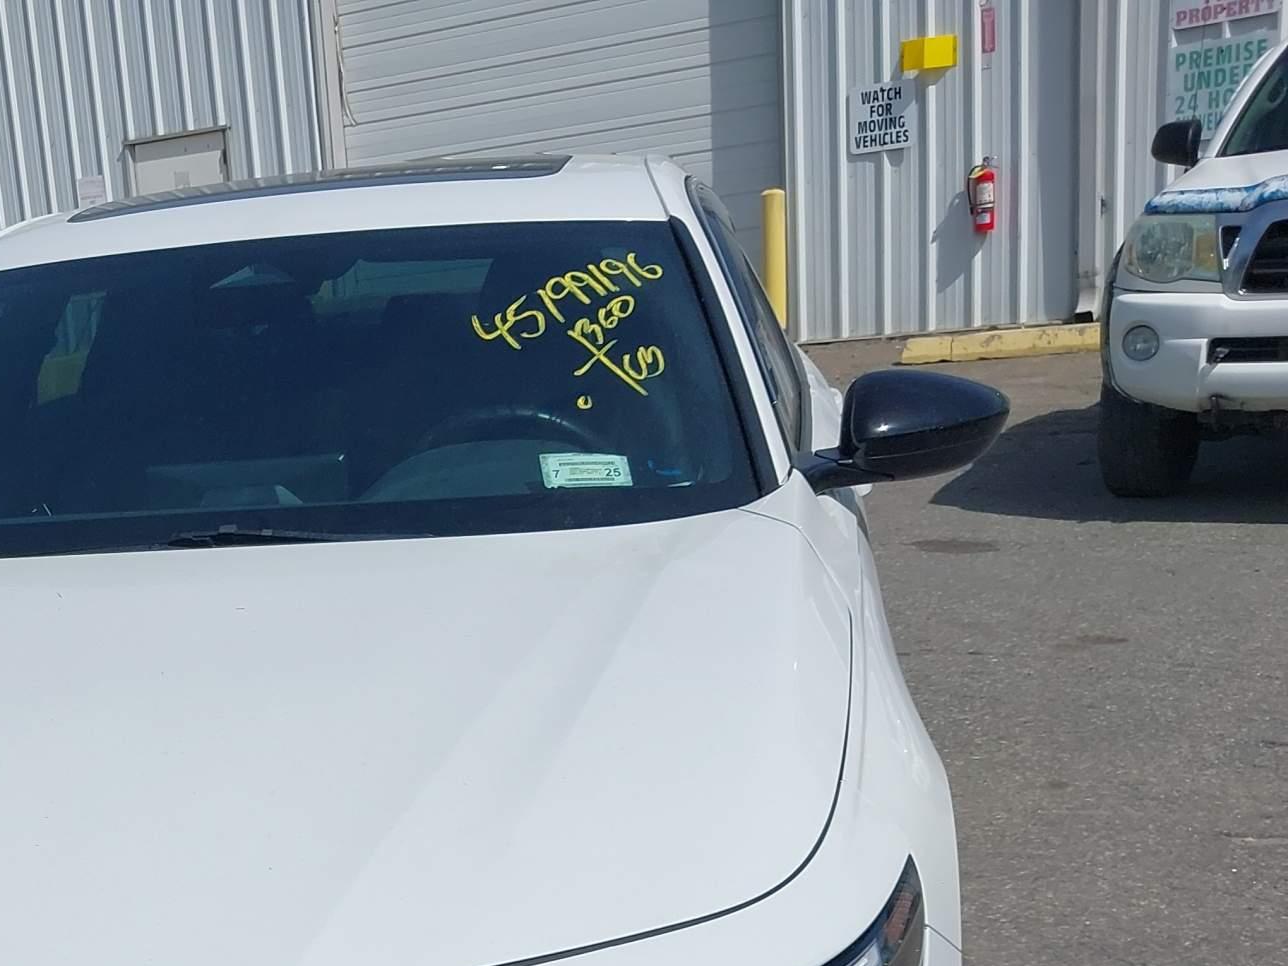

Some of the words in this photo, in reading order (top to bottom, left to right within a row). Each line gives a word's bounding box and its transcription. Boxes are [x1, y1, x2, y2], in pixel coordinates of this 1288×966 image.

[1176, 0, 1275, 26] PROPERTY
[861, 86, 902, 105] WATCH
[1175, 94, 1198, 115] 24
[870, 102, 893, 118] FOR
[857, 115, 906, 134] MOVING
[854, 129, 910, 149] VEHICLES
[471, 252, 663, 350] 45199196
[552, 469, 561, 479] 7
[604, 467, 622, 477] 25
